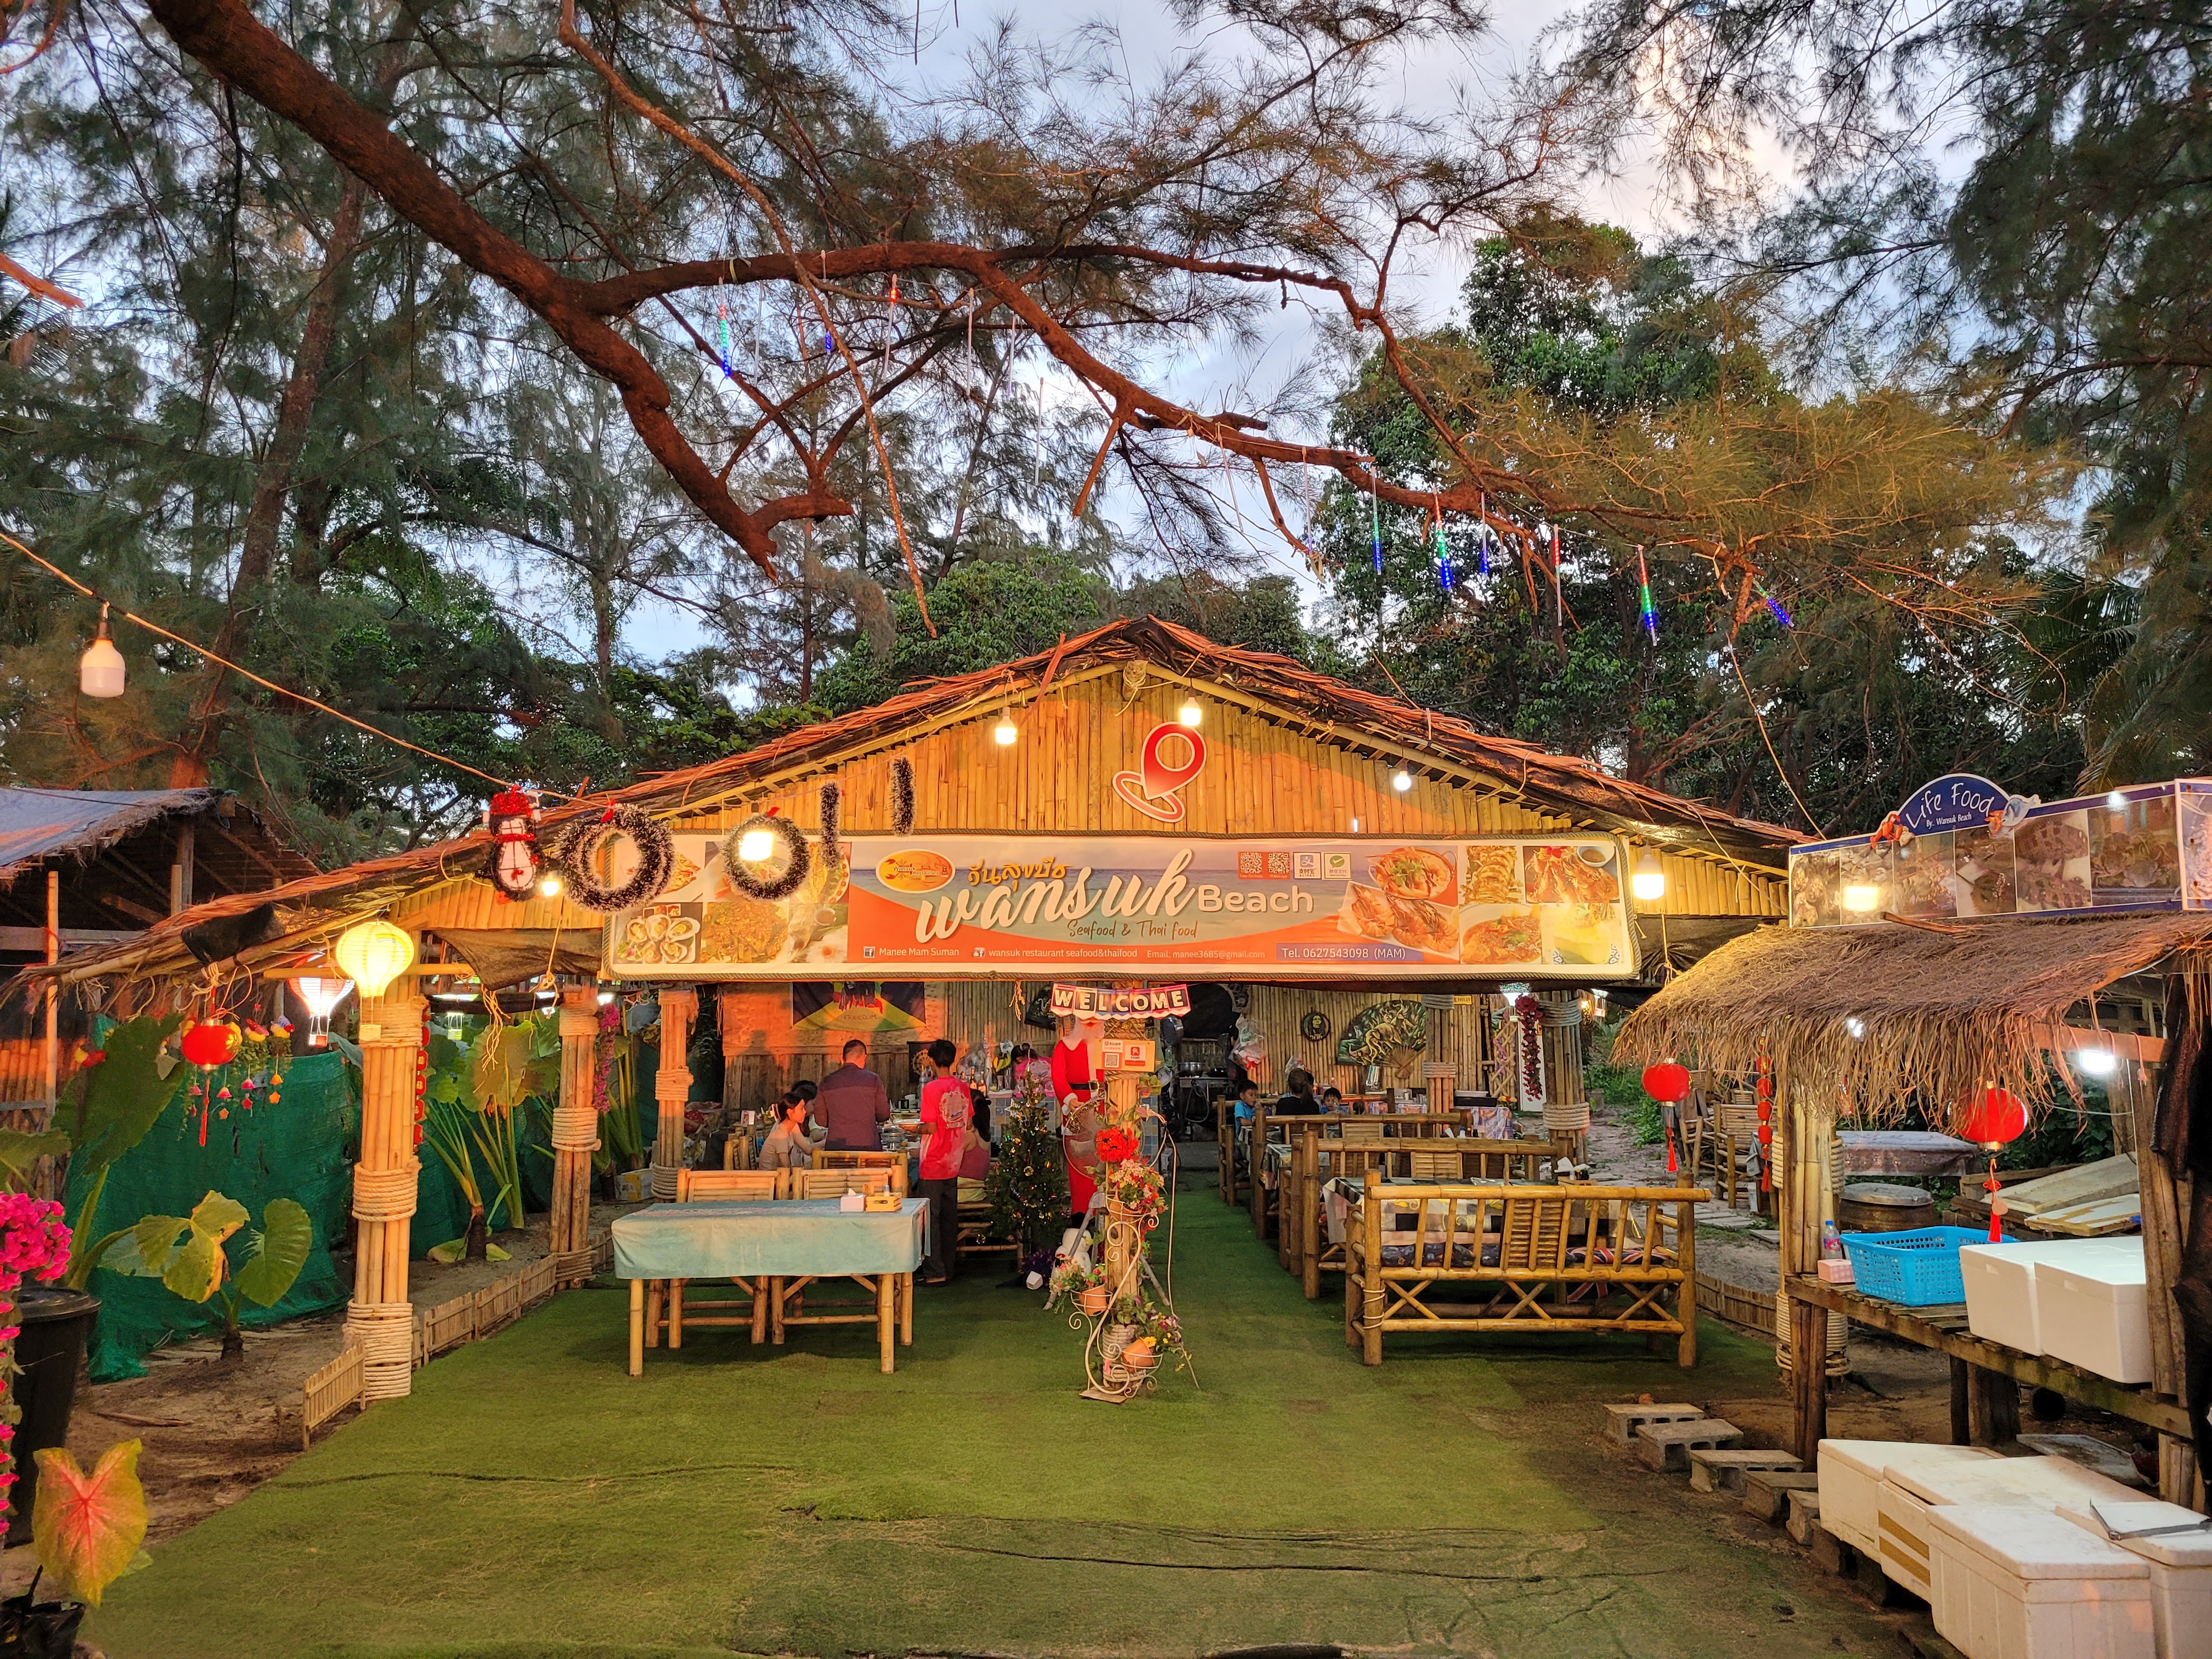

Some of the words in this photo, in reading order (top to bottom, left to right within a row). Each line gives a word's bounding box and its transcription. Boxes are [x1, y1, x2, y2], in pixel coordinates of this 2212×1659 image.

[1905, 790, 1942, 829] Life
[1951, 782, 1995, 817] Food
[1936, 816, 1956, 826] Wansuk
[1957, 812, 1972, 822] Beach
[1198, 885, 1314, 913] Beach
[1067, 919, 1117, 940] Seafood
[1121, 923, 1131, 936] &
[1136, 919, 1167, 938] Thai
[1172, 920, 1198, 940] food
[879, 947, 907, 956] Manee
[909, 947, 929, 956] Mam
[930, 947, 960, 956] Suman
[989, 948, 1020, 957] wansuk
[1065, 949, 1137, 957] seafood&thaifood
[1147, 950, 1171, 958] Email:
[1172, 950, 1265, 960] manee3685@gmail.com
[1282, 948, 1301, 958] Tel.
[1303, 948, 1369, 958] 0627543098
[1374, 947, 1406, 960] (MAM)
[1054, 989, 1184, 1013] WELCOME
